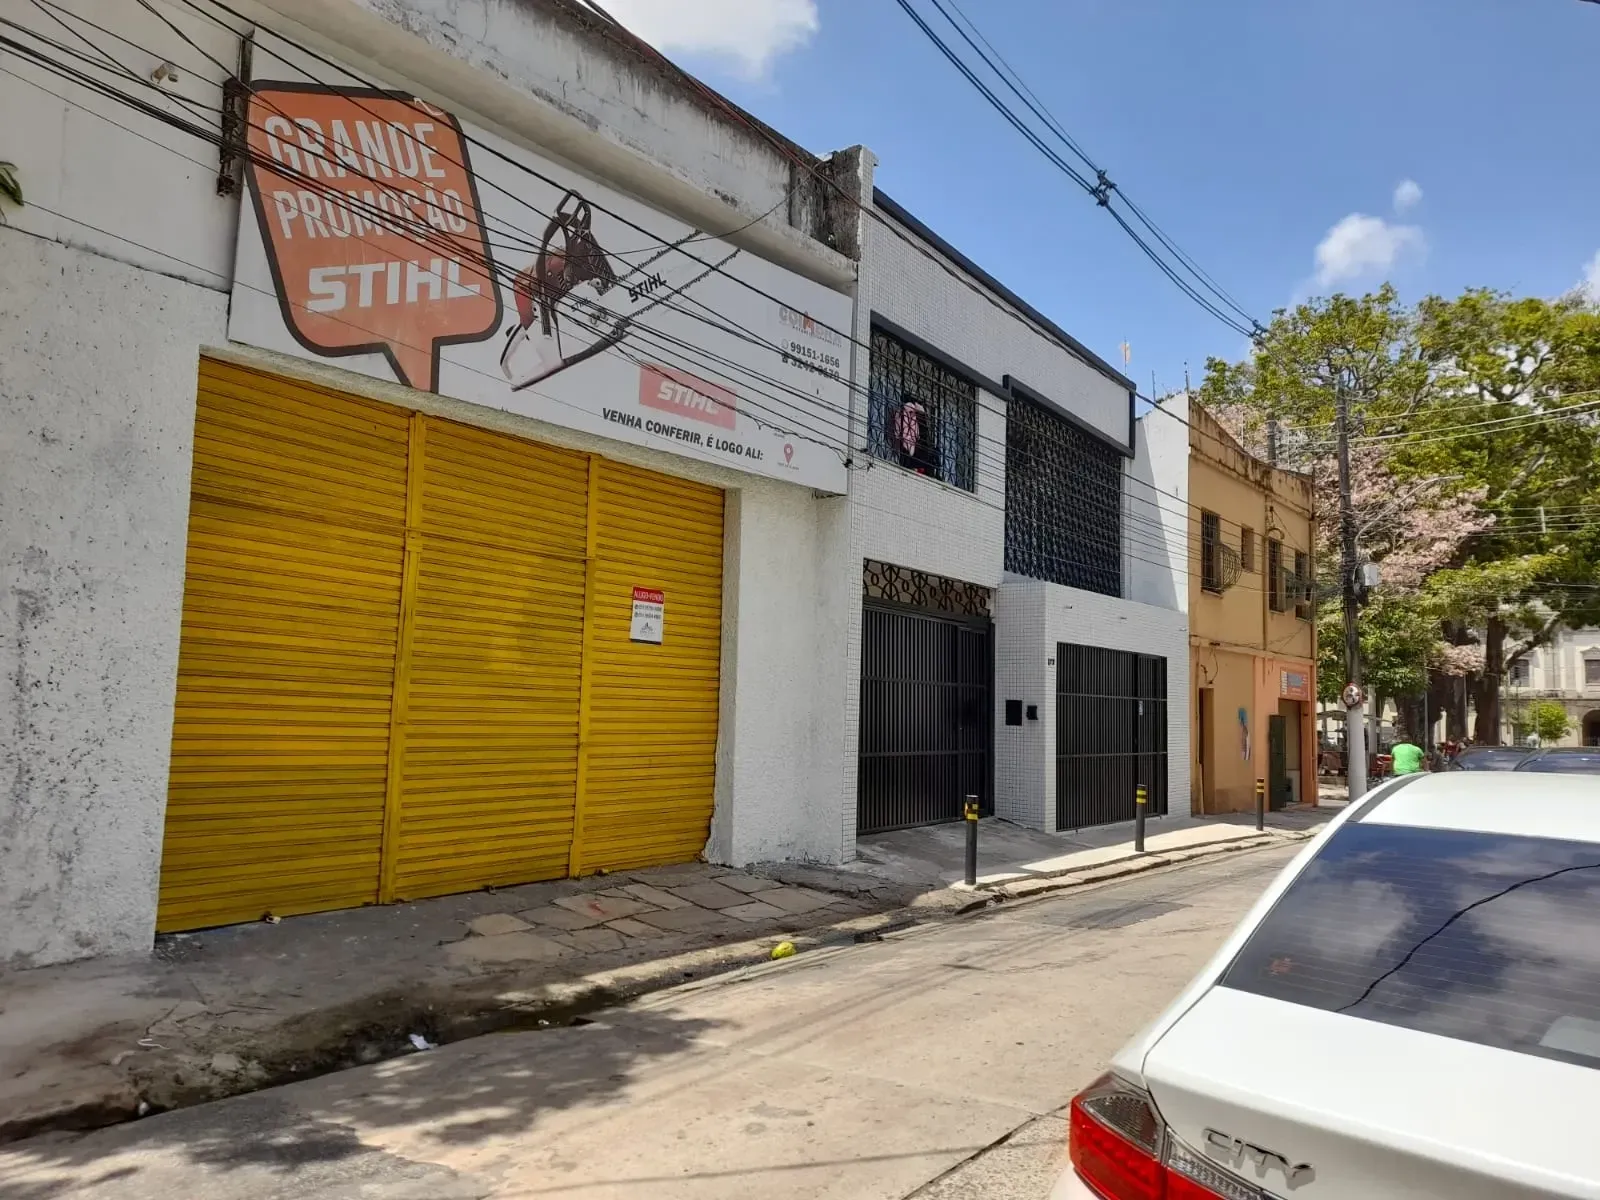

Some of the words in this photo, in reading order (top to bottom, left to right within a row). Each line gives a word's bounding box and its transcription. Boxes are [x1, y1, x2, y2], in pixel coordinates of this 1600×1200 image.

[264, 116, 446, 178] GRANDE
[273, 181, 467, 242] PROMOÇÃO
[307, 256, 481, 313] STIHL
[628, 272, 667, 304] STIHL
[790, 341, 840, 369] 99151-1656
[657, 380, 719, 416] STIHL
[602, 407, 642, 429] VENHA
[645, 420, 704, 447] CONFERIR,
[706, 433, 713, 448] É
[715, 438, 743, 455] LOGO
[745, 446, 763, 461] ALI:
[1203, 1126, 1314, 1180] CITY
